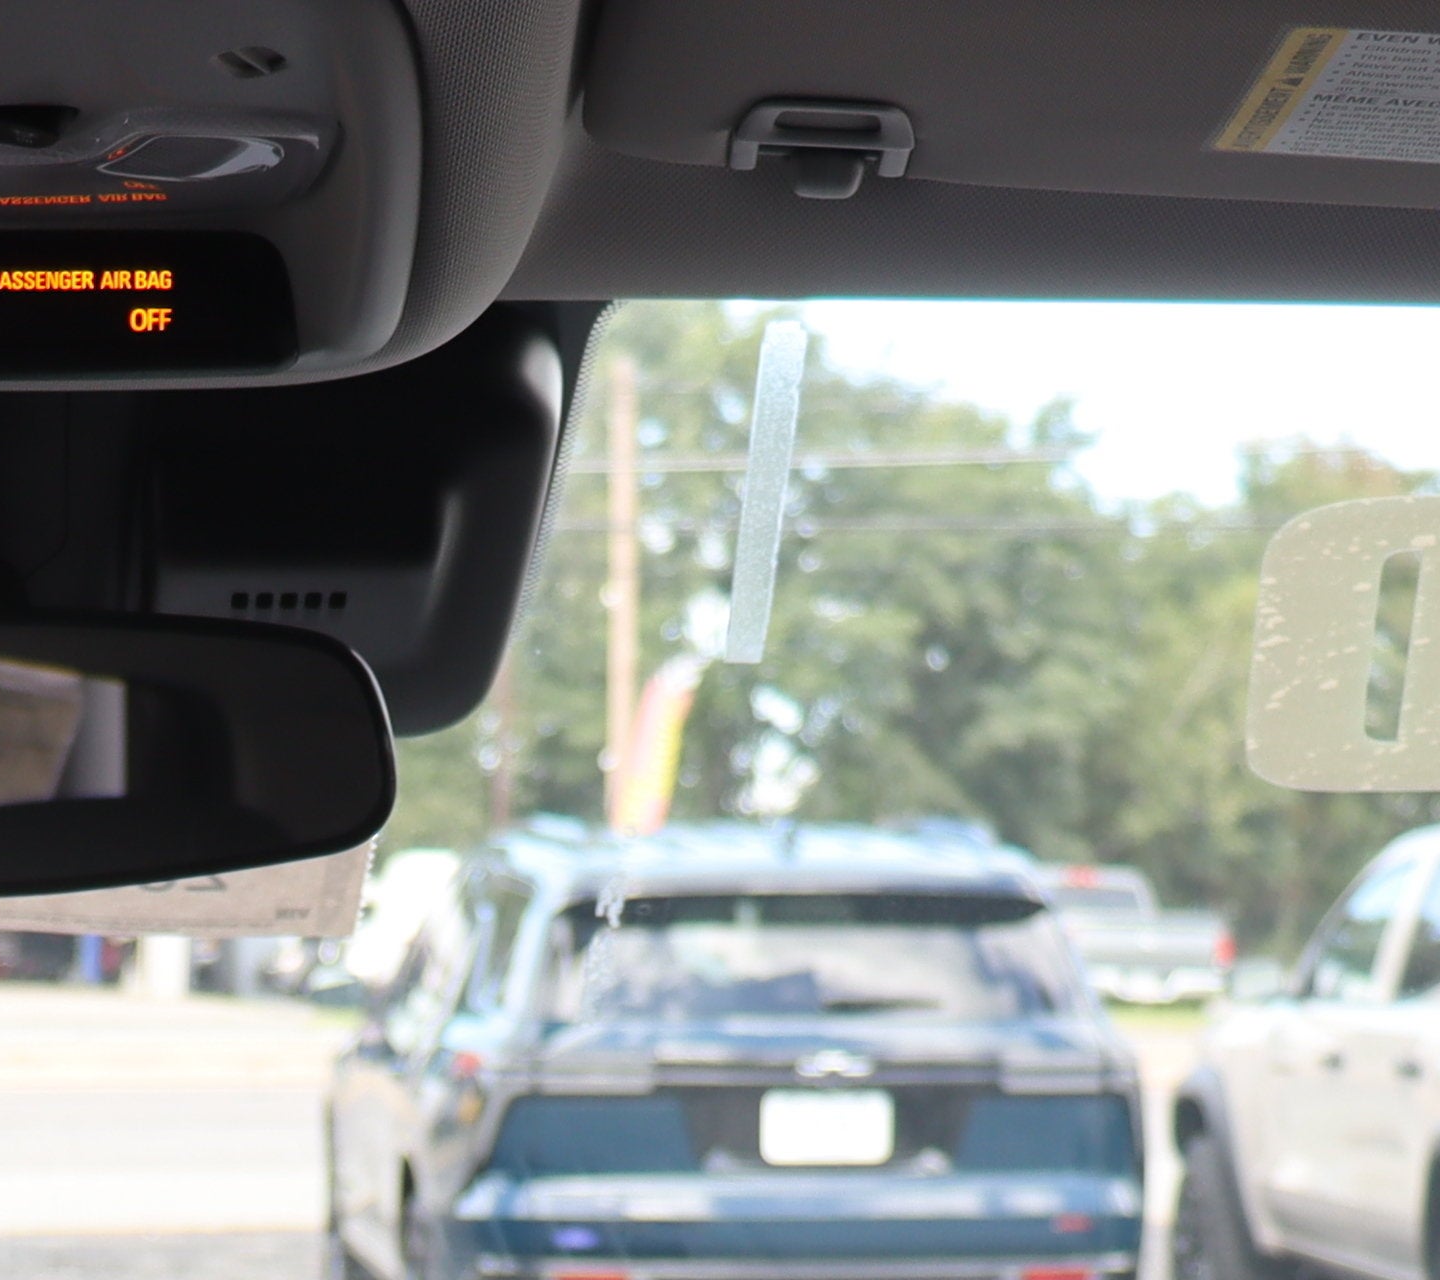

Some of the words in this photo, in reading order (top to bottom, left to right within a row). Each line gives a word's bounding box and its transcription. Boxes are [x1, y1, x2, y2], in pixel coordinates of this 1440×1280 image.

[1356, 32, 1419, 44] EVEN
[100, 270, 131, 290] AIR
[134, 270, 172, 290] BAG
[129, 308, 172, 332] OFF
